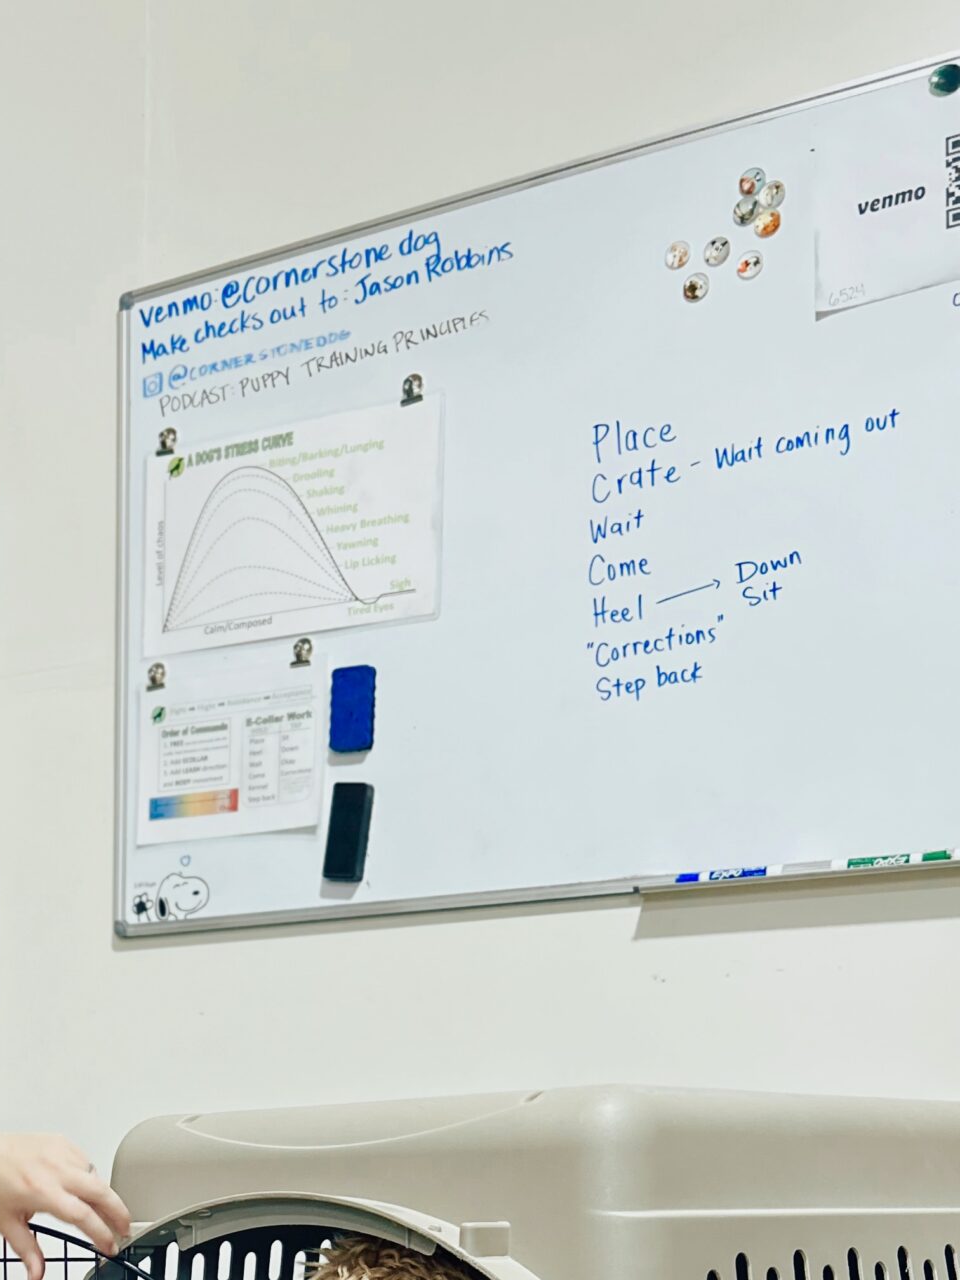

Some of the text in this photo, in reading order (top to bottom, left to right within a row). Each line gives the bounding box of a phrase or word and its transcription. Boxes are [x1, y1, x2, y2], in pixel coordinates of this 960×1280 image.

[857, 185, 926, 215] venmo
[399, 229, 441, 264] dog
[141, 334, 190, 364] Make
[194, 310, 264, 343] checks
[270, 297, 306, 324] out
[355, 272, 419, 304] Jason
[425, 242, 514, 282] Robbins
[240, 367, 290, 397] PUPPY
[301, 341, 388, 377] TRAINING
[187, 431, 294, 468] A DOG'S STRESS CURVE
[592, 459, 681, 503] Crate
[715, 437, 763, 469] Wait
[864, 408, 900, 432] out
[593, 420, 677, 463] Place
[292, 467, 336, 483] Drooling
[306, 484, 345, 498] Shaking
[317, 502, 358, 516] Whining
[360, 513, 410, 529] Breathing
[590, 508, 645, 544] Wait
[588, 554, 652, 586] Come
[593, 551, 802, 627] Heel Down
[742, 581, 783, 606] Sit
[596, 662, 703, 701] Step back
